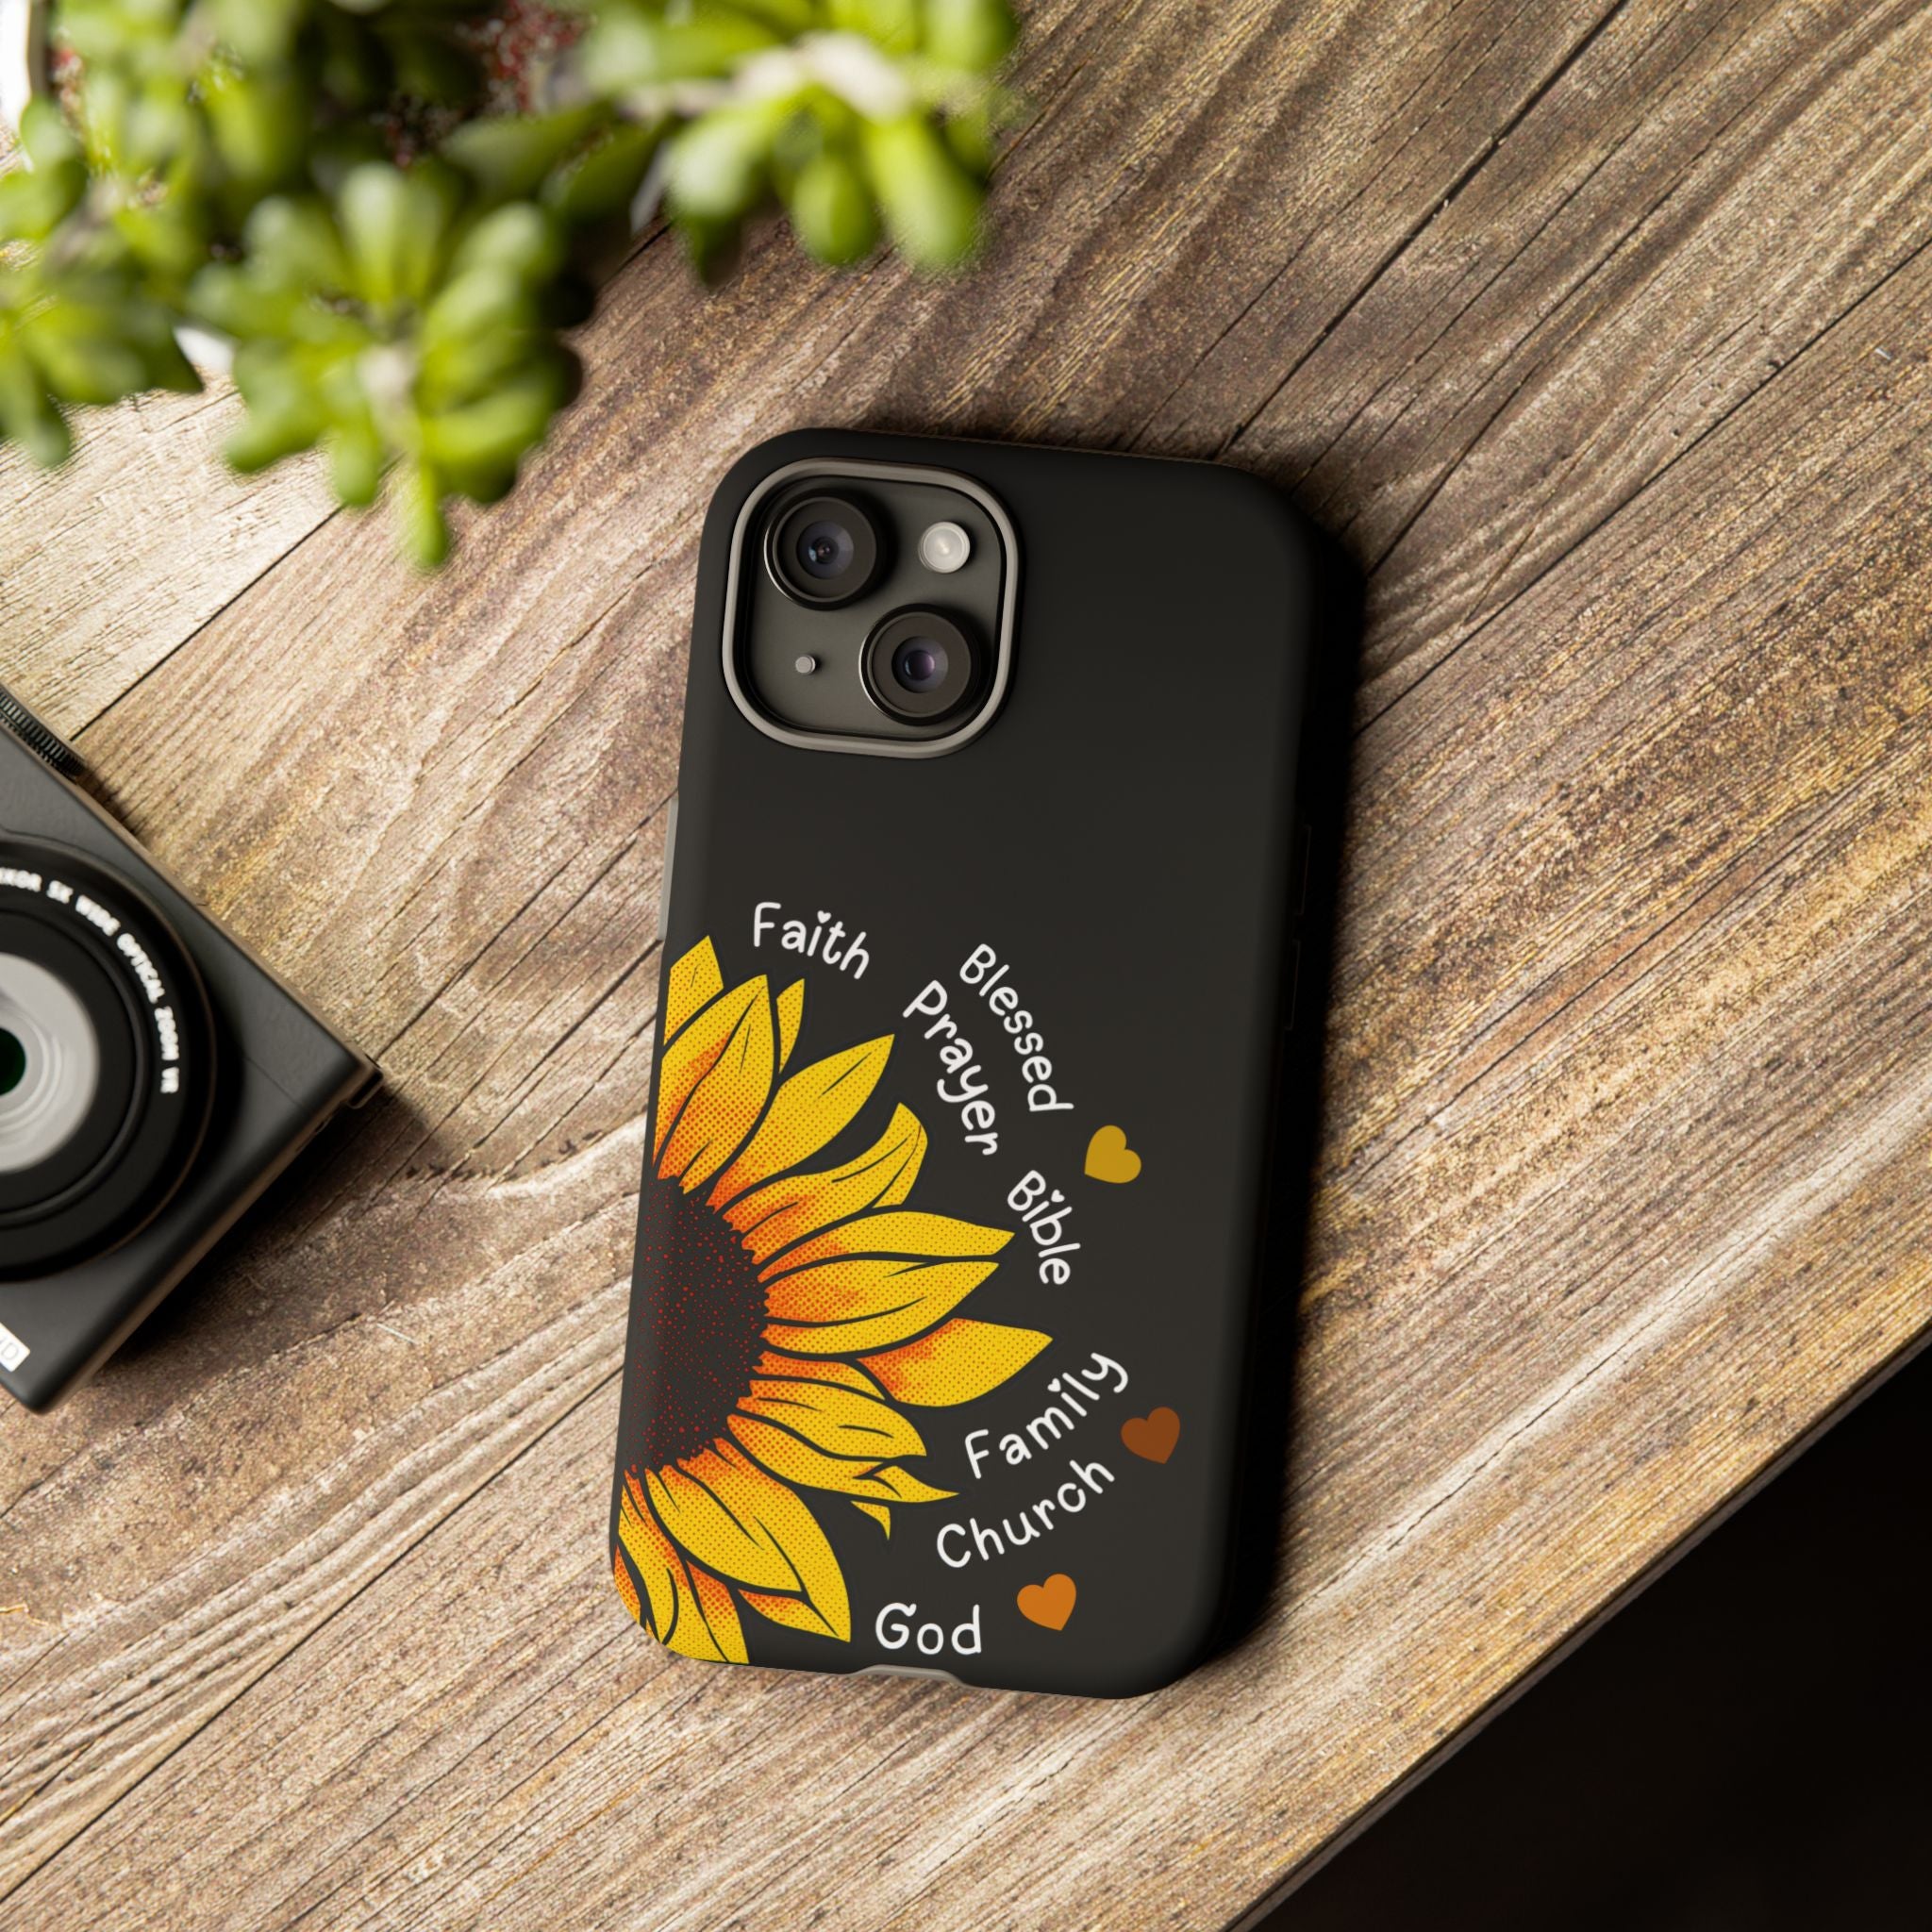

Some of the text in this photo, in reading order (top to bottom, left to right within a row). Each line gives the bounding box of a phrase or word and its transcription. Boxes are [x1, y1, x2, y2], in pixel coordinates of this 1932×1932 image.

[0, 867, 42, 892] KOR
[75, 894, 121, 937] WIDE
[116, 932, 165, 1004] OPTICAL
[154, 1006, 179, 1061] ZOOM
[753, 901, 871, 980] Faith
[902, 978, 999, 1157] Prayer
[958, 942, 1074, 1113] Blessed
[1006, 1169, 1082, 1286] Bible
[963, 1351, 1129, 1480] Family
[936, 1458, 1116, 1569] Church
[874, 1601, 983, 1657] God
